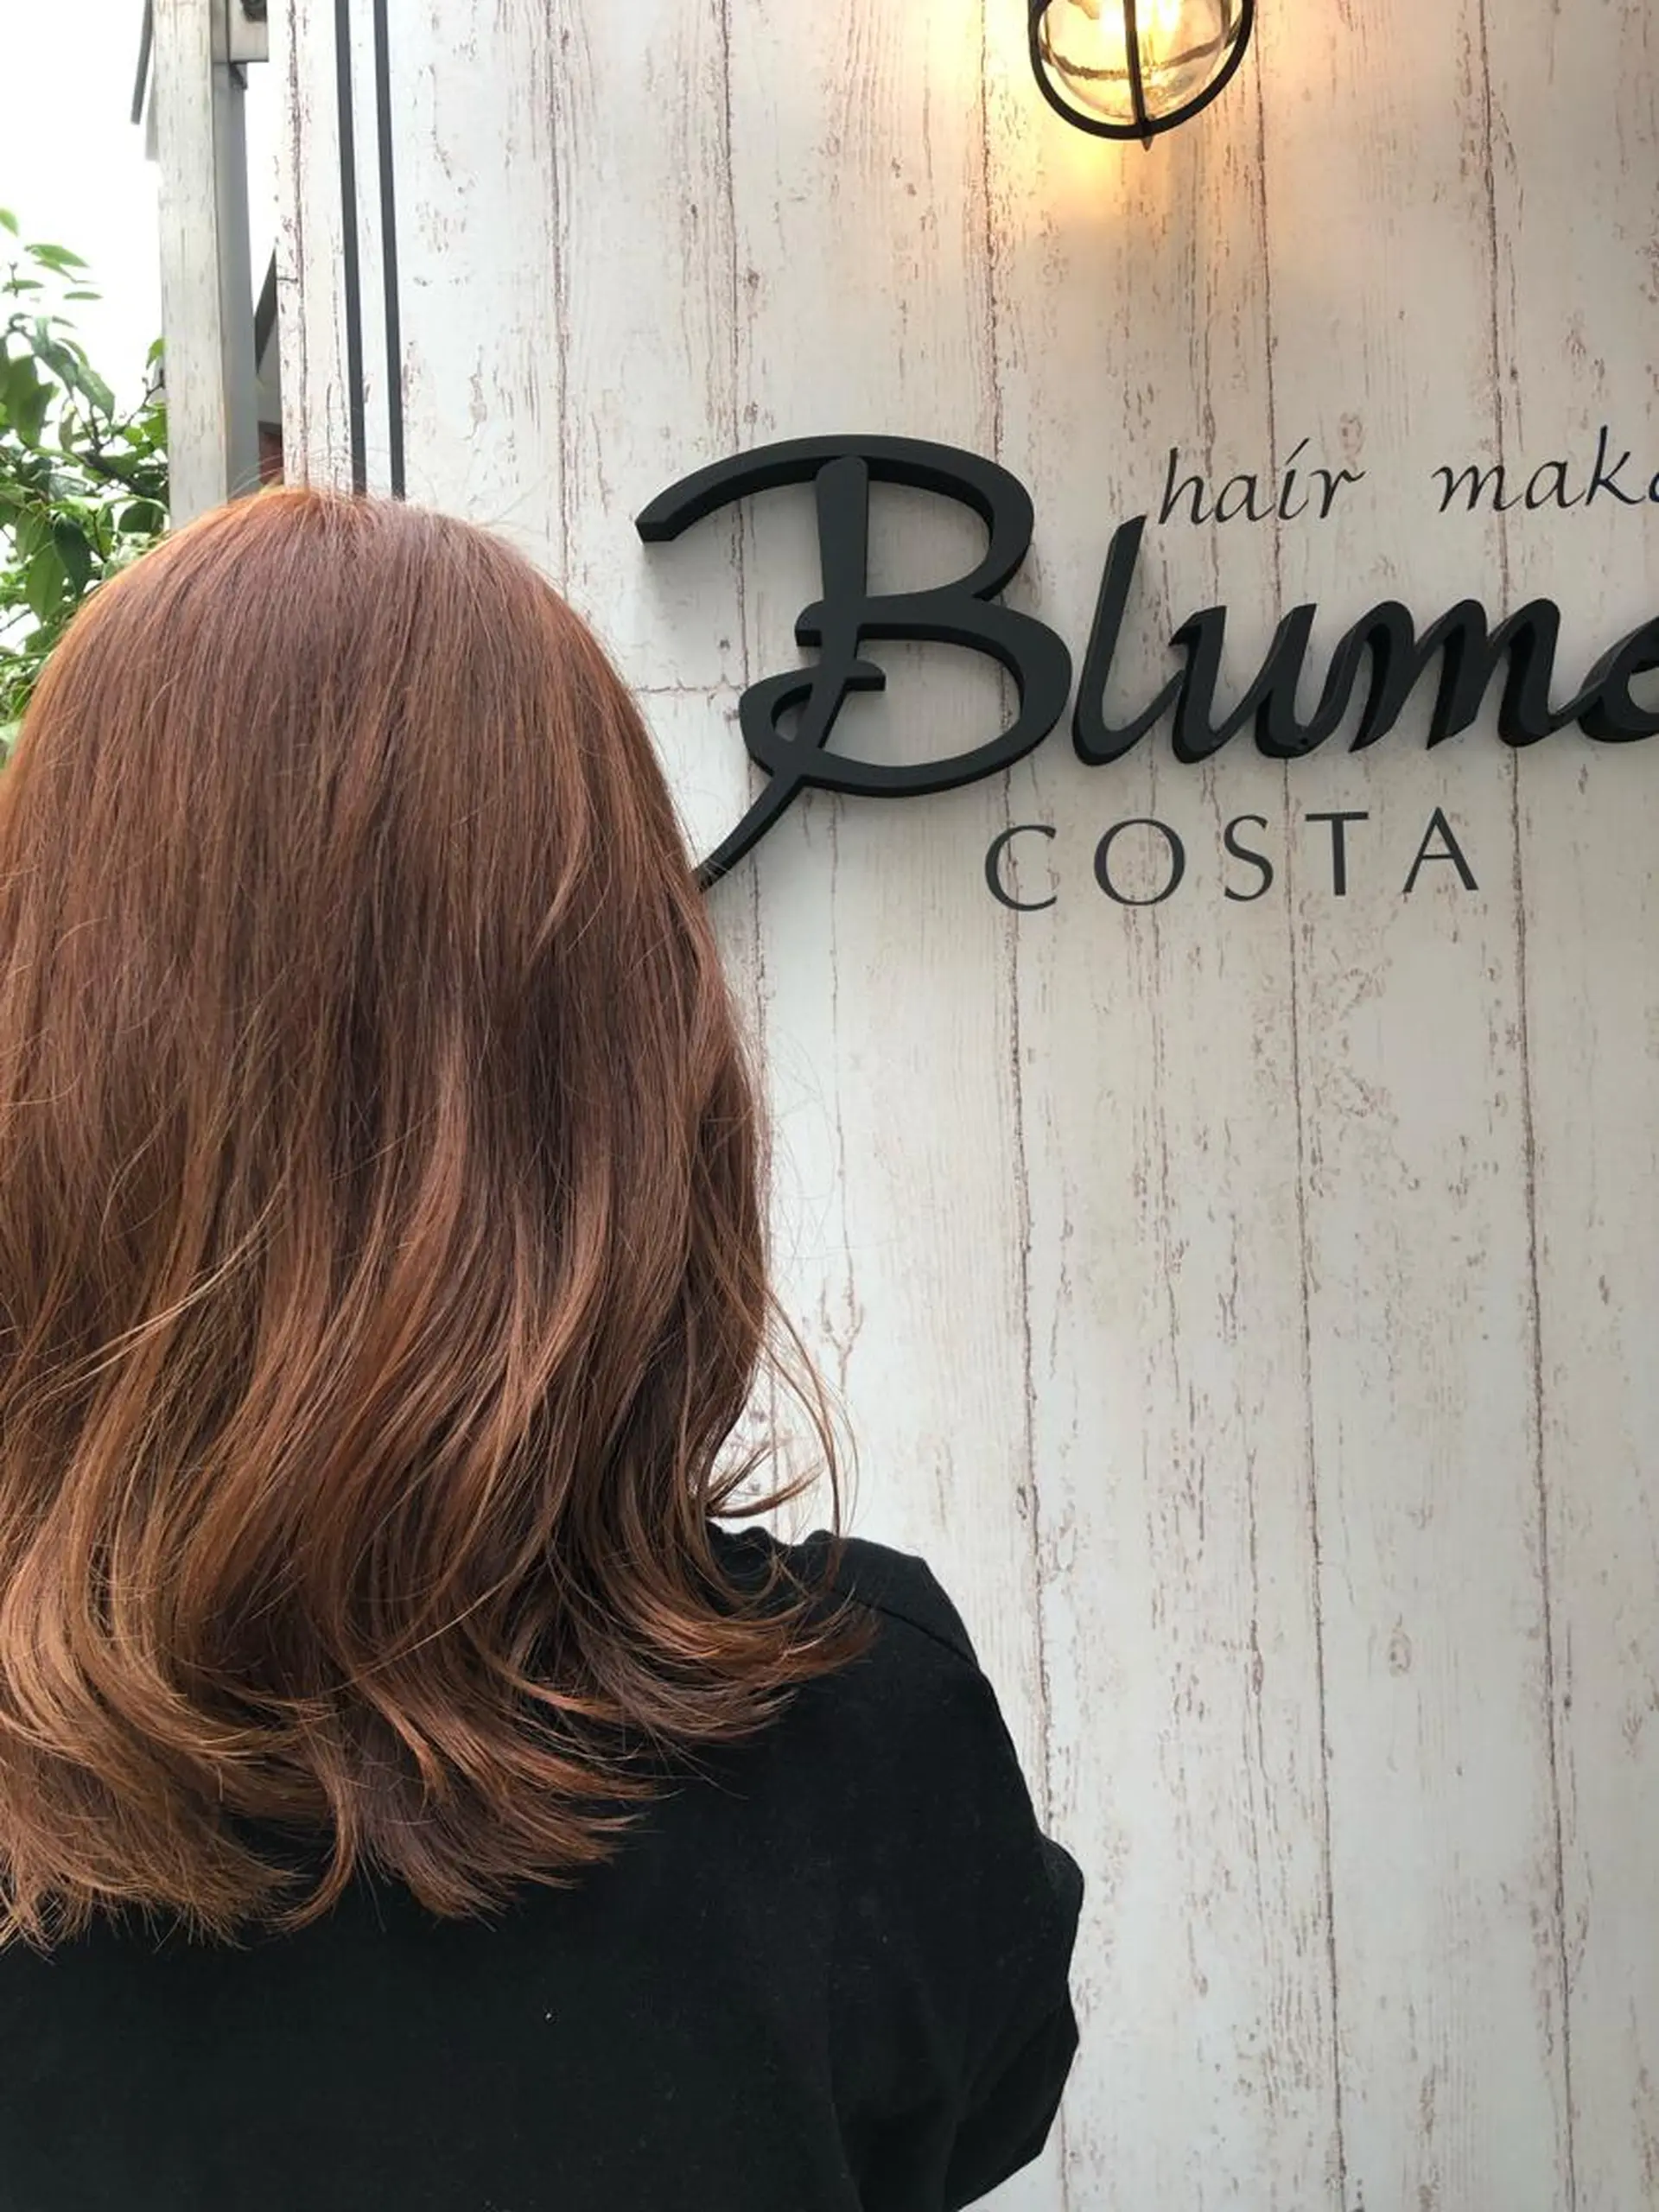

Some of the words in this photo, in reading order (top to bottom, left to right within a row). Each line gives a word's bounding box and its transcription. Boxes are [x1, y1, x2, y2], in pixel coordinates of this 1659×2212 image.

[1158, 437, 1366, 525] hair
[1432, 424, 1659, 512] mak
[984, 806, 1479, 912] COSTA
